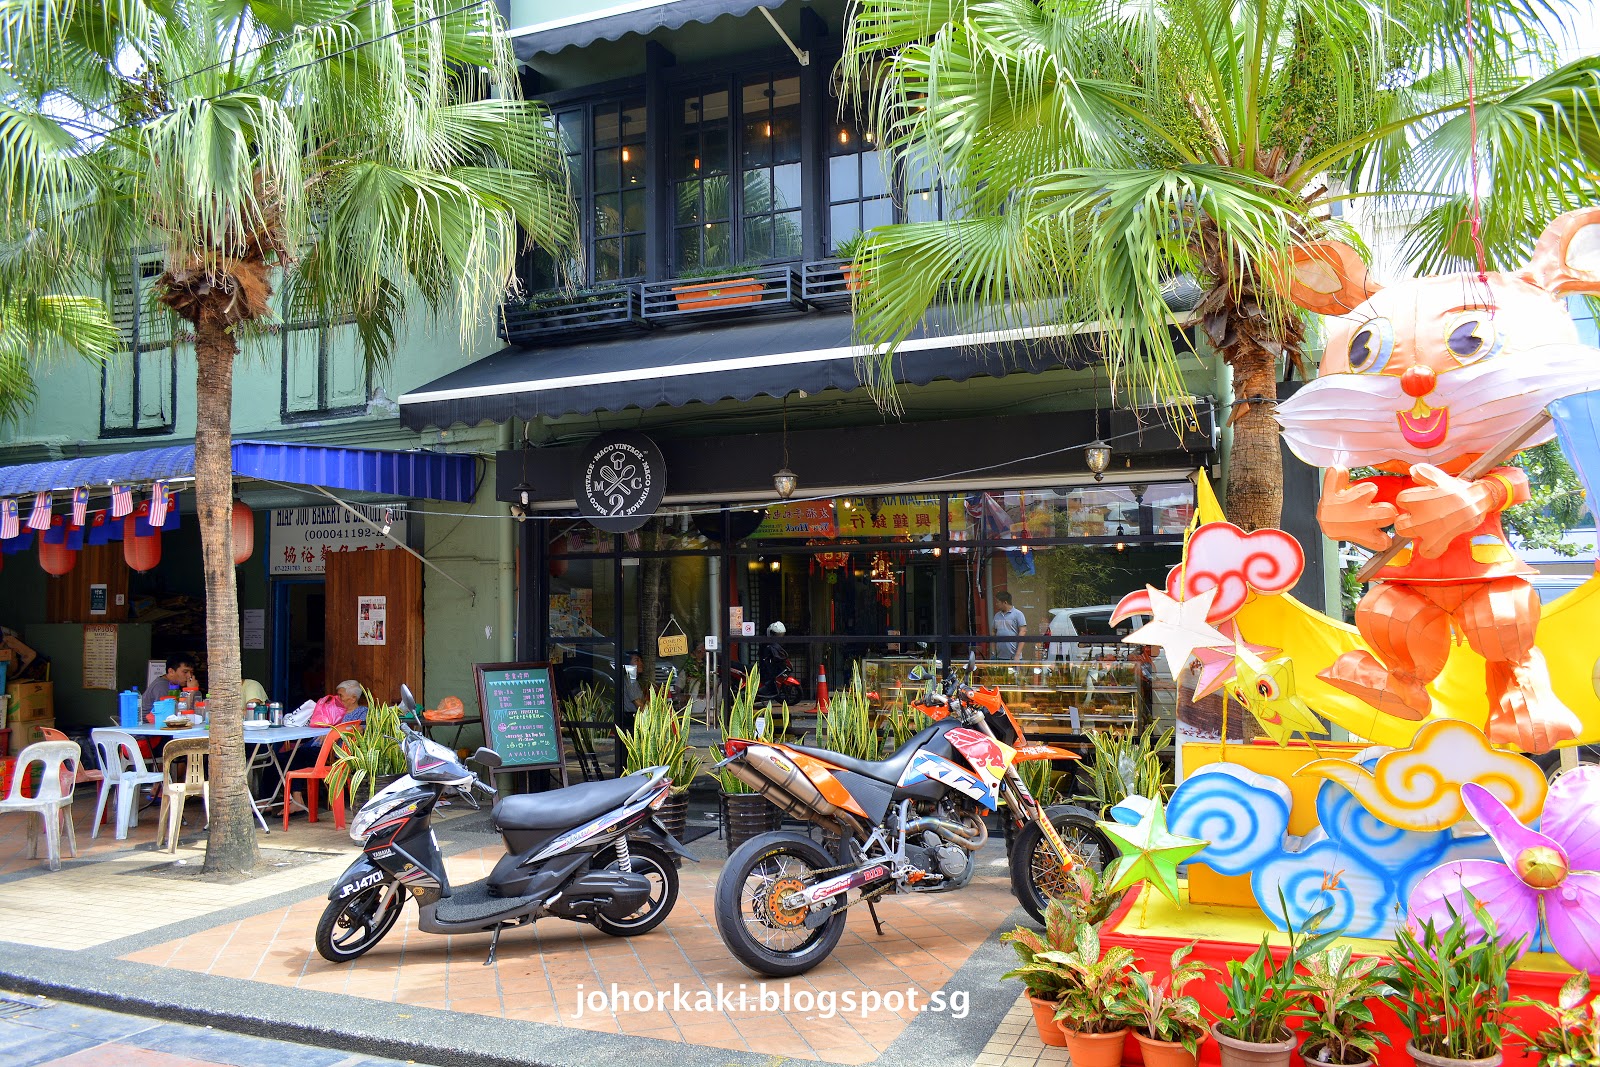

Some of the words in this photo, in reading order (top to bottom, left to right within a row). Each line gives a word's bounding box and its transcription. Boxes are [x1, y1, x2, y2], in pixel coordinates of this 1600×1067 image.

[594, 445, 614, 461] MACO
[614, 444, 643, 459] VINTAGE
[586, 463, 595, 498] VINTAGE
[642, 461, 651, 486] MACO
[593, 481, 604, 491] M
[631, 477, 642, 489] C
[590, 497, 608, 516] MACO
[626, 487, 650, 515] VINTAGE
[312, 506, 341, 525] BAKERY
[305, 528, 388, 541] (000041192-A
[372, 848, 392, 857] YAMAHA
